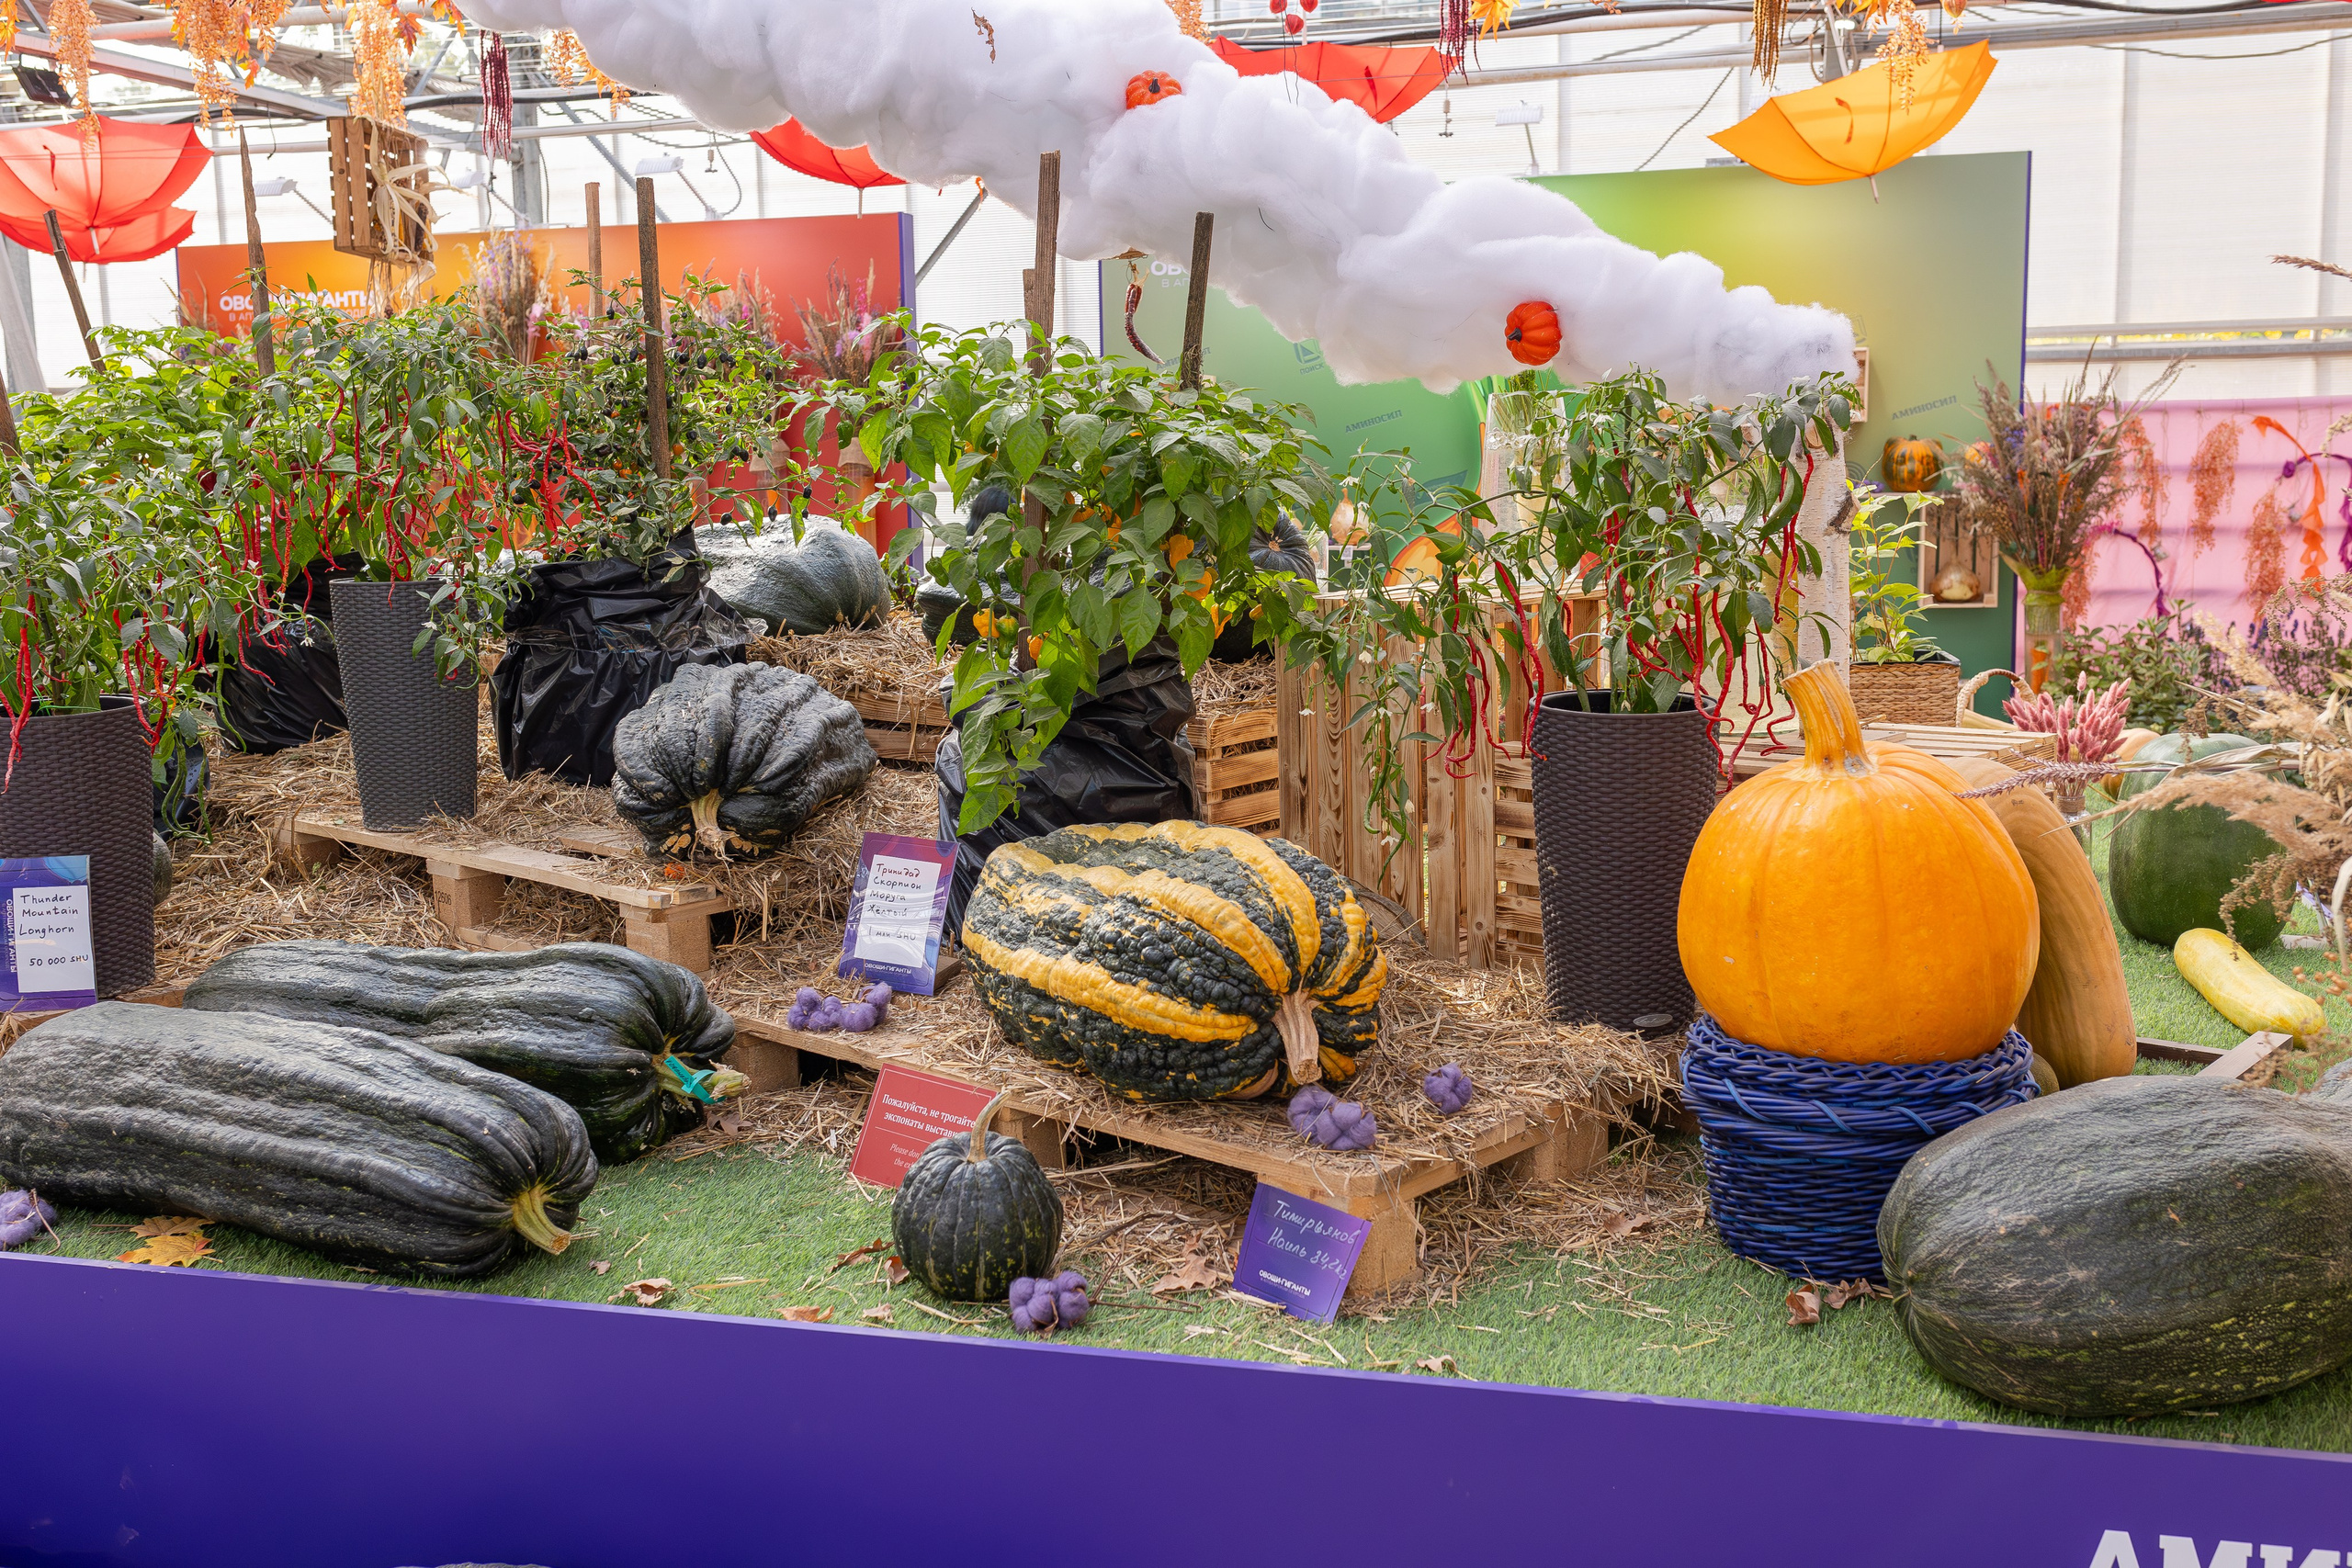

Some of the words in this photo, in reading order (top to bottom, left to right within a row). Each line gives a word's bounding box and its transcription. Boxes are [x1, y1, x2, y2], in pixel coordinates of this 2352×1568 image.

[1892, 395, 1958, 421] АМИНОСИЛ
[1345, 410, 1403, 434] АМИНОСИЛ
[876, 863, 921, 878] Тринидад
[873, 876, 922, 890] Скорпион
[20, 894, 72, 904] Thunder
[869, 890, 906, 902] Моруга
[22, 906, 79, 917] Mountain
[6, 898, 17, 973] ОВОЩИ-ГИГАНТЫ
[19, 923, 74, 939] Longhorn
[28, 958, 43, 966] 50
[48, 956, 66, 965] 000
[70, 954, 89, 963] SHU
[865, 963, 912, 975] ОВОЩИ-ГИГАНТЫ
[882, 1093, 929, 1117] Пожалуйста,
[929, 1109, 940, 1118] не
[940, 1111, 976, 1129] трогайте
[883, 1111, 925, 1131] экспонаты
[889, 1143, 909, 1156] Please
[893, 1157, 904, 1168] the
[1267, 1227, 1307, 1258] Наиль
[1259, 1269, 1311, 1296] ОВОЩИ-ГИГАНТЫ
